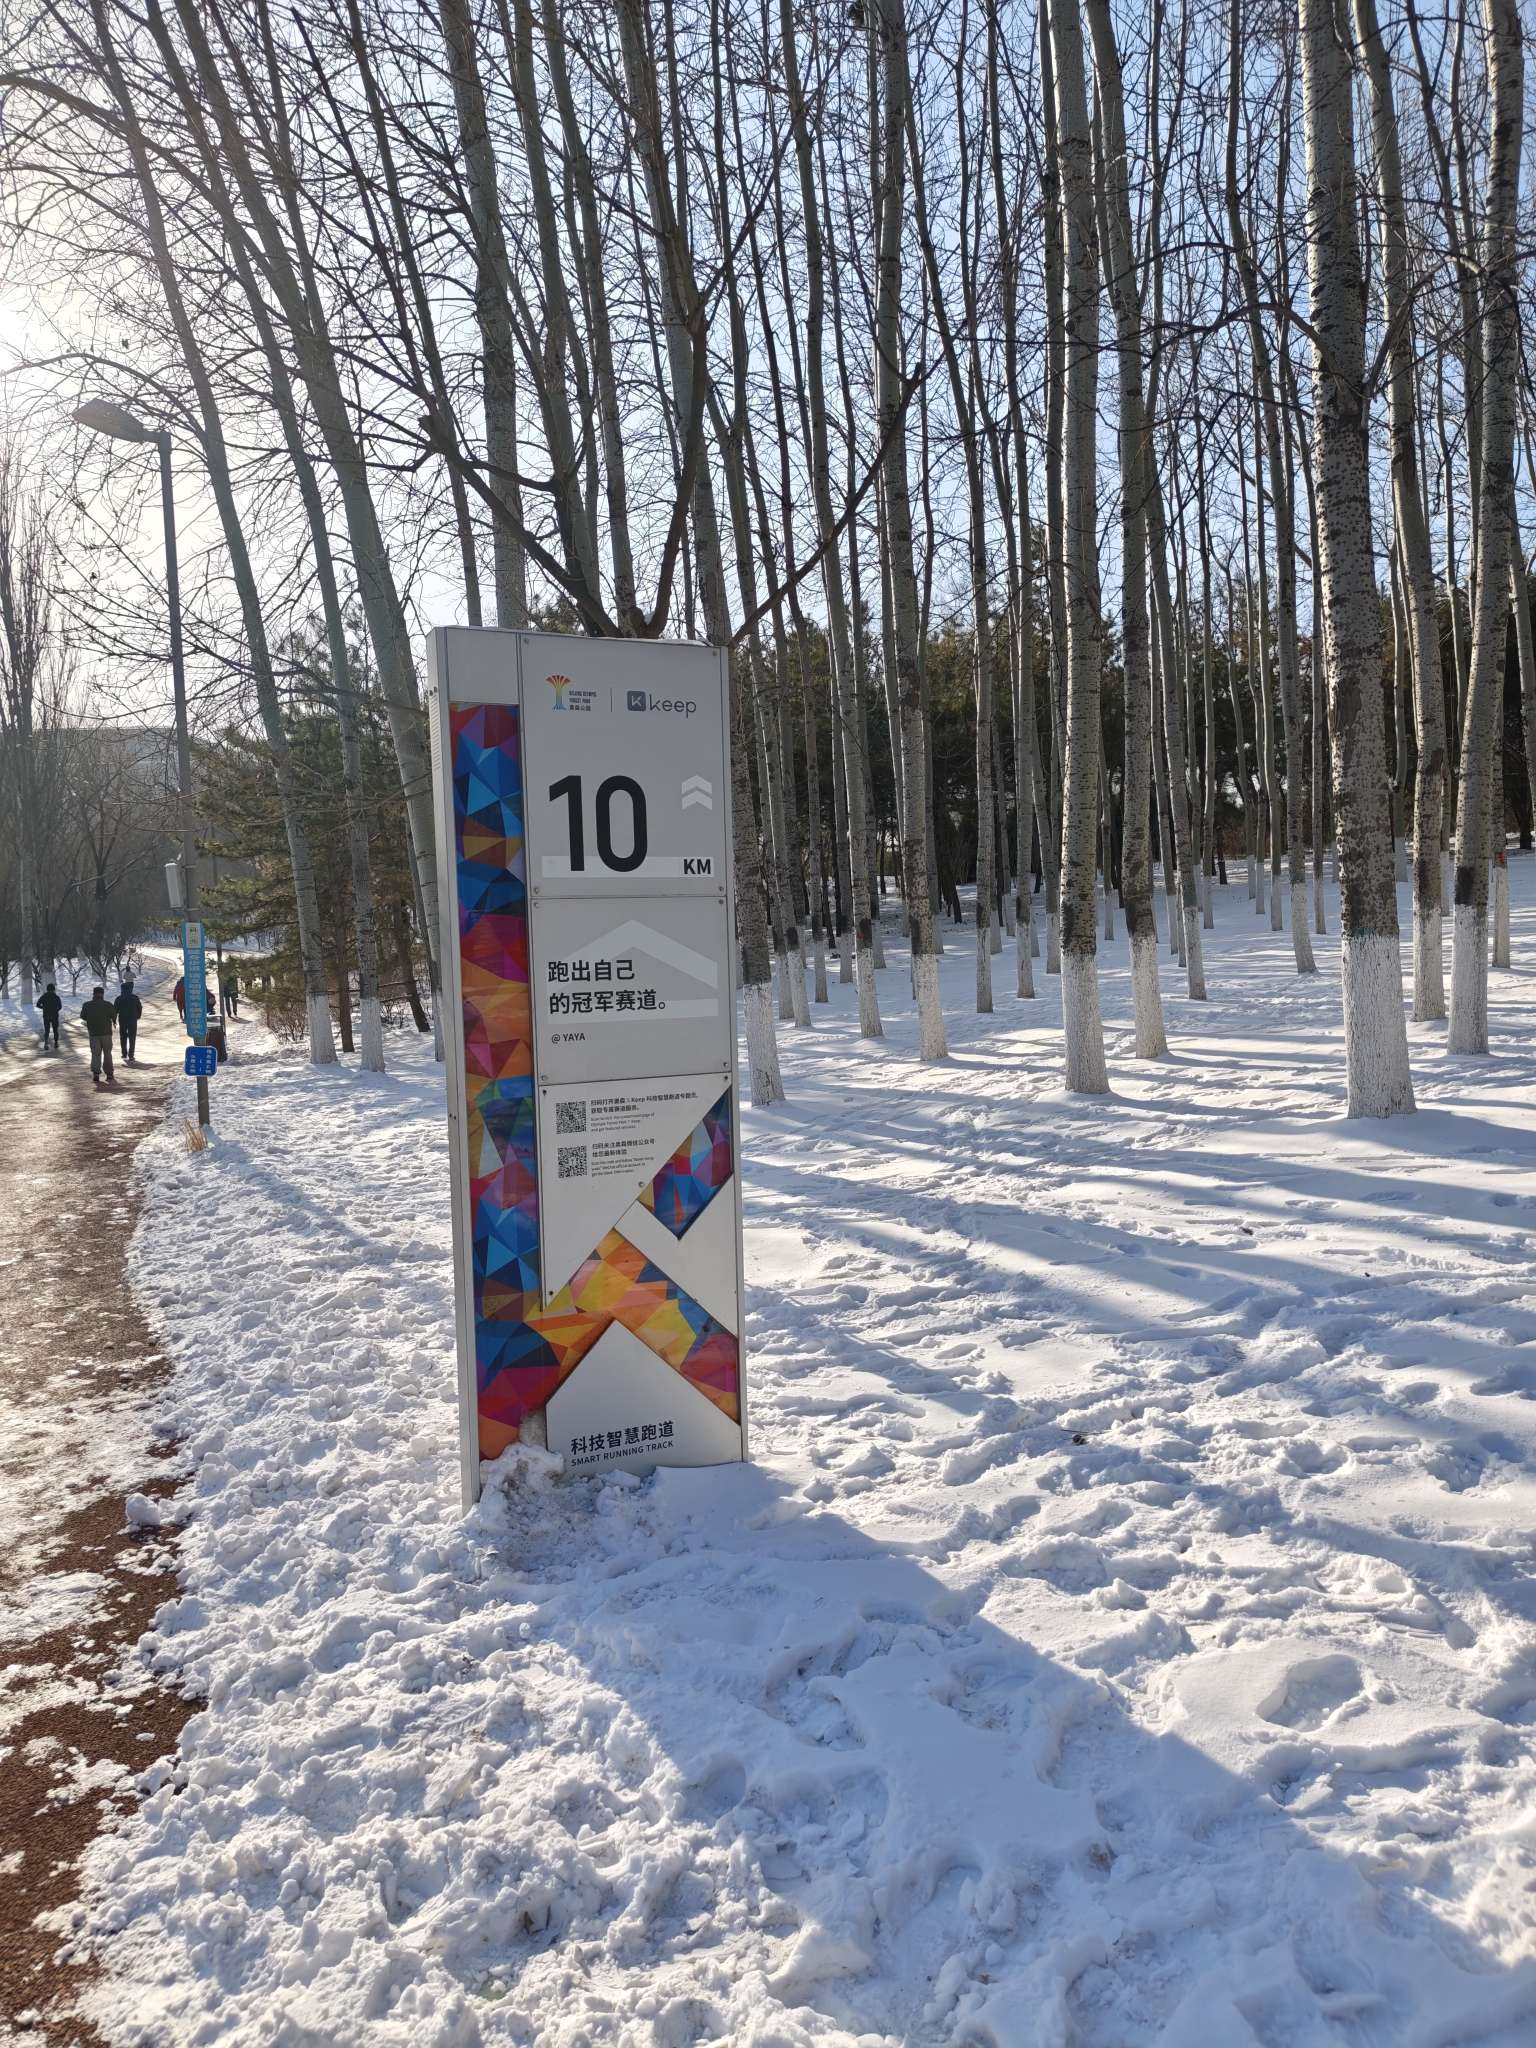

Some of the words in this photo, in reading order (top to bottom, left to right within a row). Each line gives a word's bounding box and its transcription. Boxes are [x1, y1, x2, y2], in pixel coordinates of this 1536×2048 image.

[649, 693, 697, 719] keep
[549, 775, 648, 872] 10
[683, 858, 712, 875] KM
[548, 959, 635, 983] 跑出自己
[549, 989, 666, 1015] 的冠军赛道。
[563, 1032, 586, 1042] YAYA
[570, 1420, 674, 1456] 科技智慧跑道
[571, 1453, 601, 1467] SMART
[603, 1445, 644, 1461] RUNNING
[645, 1439, 674, 1453] TRACK
